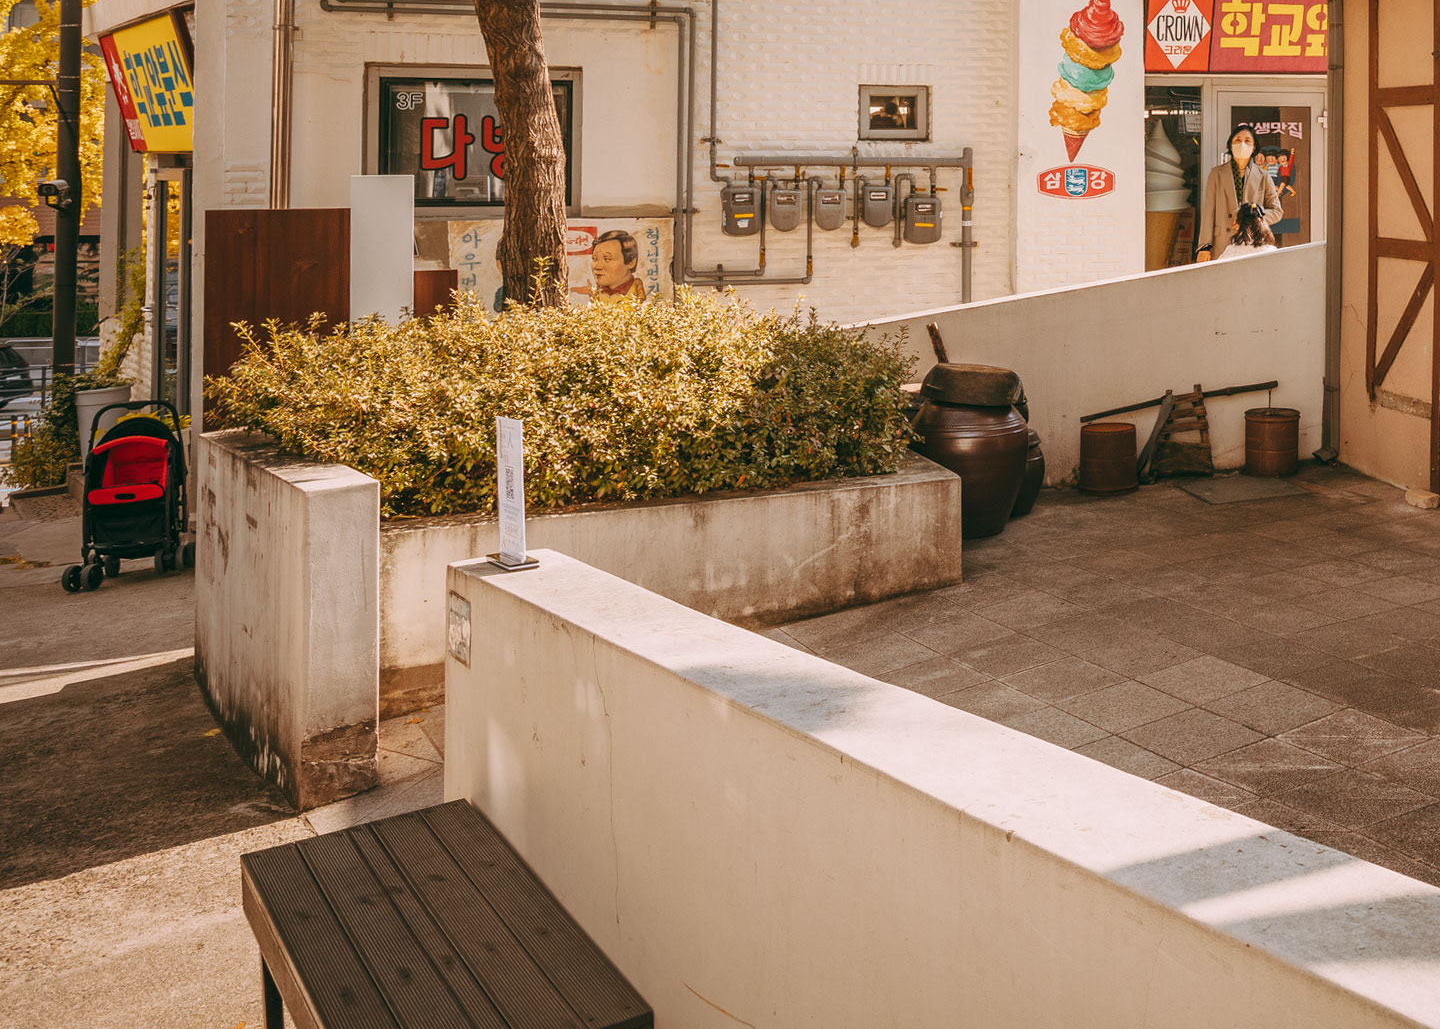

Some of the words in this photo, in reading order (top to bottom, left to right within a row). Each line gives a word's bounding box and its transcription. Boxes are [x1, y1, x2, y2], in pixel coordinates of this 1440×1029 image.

[1156, 15, 1204, 42] CROWN
[1164, 45, 1192, 55] 크라운
[396, 91, 424, 110] 3F
[1238, 121, 1303, 140] 생맛집
